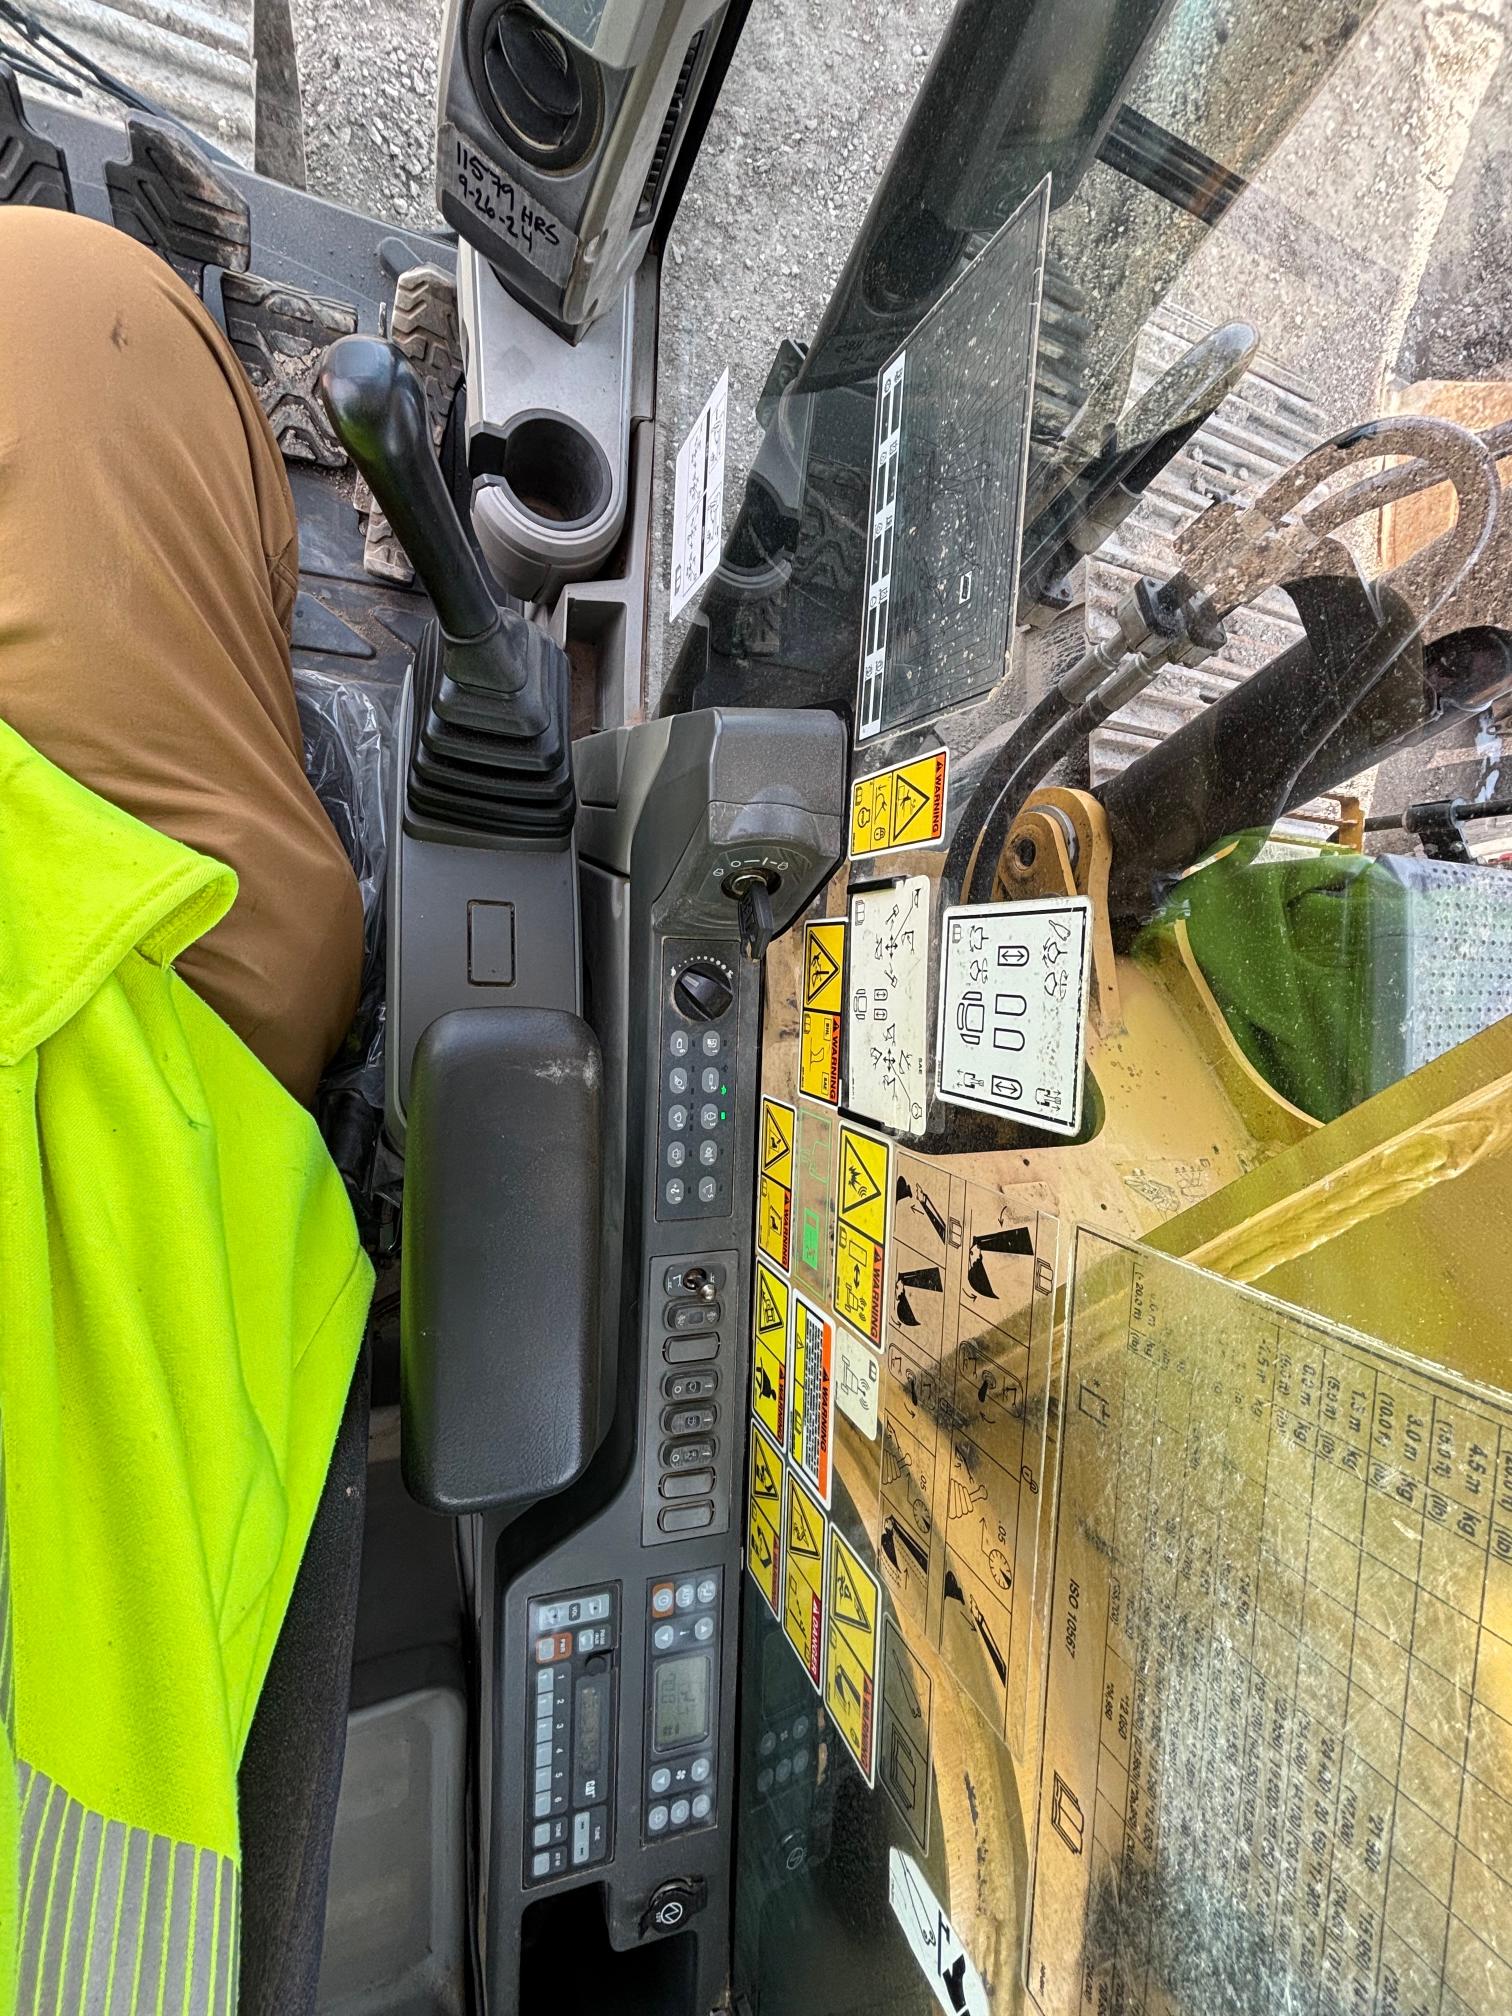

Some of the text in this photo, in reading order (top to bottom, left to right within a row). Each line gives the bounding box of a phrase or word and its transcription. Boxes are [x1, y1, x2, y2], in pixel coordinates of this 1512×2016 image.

[457, 141, 560, 246] 11579 HRS
[458, 174, 533, 253] 9-26-24
[932, 773, 942, 833] WARNING
[830, 1035, 839, 1100] WARNING
[782, 1208, 790, 1265] WARNING
[870, 1267, 881, 1339] WARNING
[776, 1382, 785, 1440] WARNING
[821, 1386, 829, 1453] WARNING
[1293, 1421, 1311, 1443] kg
[1348, 1415, 1362, 1432] m
[1378, 1392, 1395, 1429] (10.0
[1319, 1435, 1336, 1459] (lb)
[1343, 1449, 1362, 1471] kg
[1404, 1415, 1424, 1462] 3.0 m
[1396, 1478, 1417, 1503] kg
[1465, 1444, 1488, 1494] 4.5 m
[997, 1519, 1007, 1543] .05
[1428, 1494, 1448, 1522] (lb)
[1457, 1511, 1482, 1537] kg
[1065, 1578, 1080, 1659] ISO 10567
[811, 1617, 820, 1677] DANGER
[861, 1699, 871, 1768] WARNING
[585, 1780, 596, 1797] CAT
